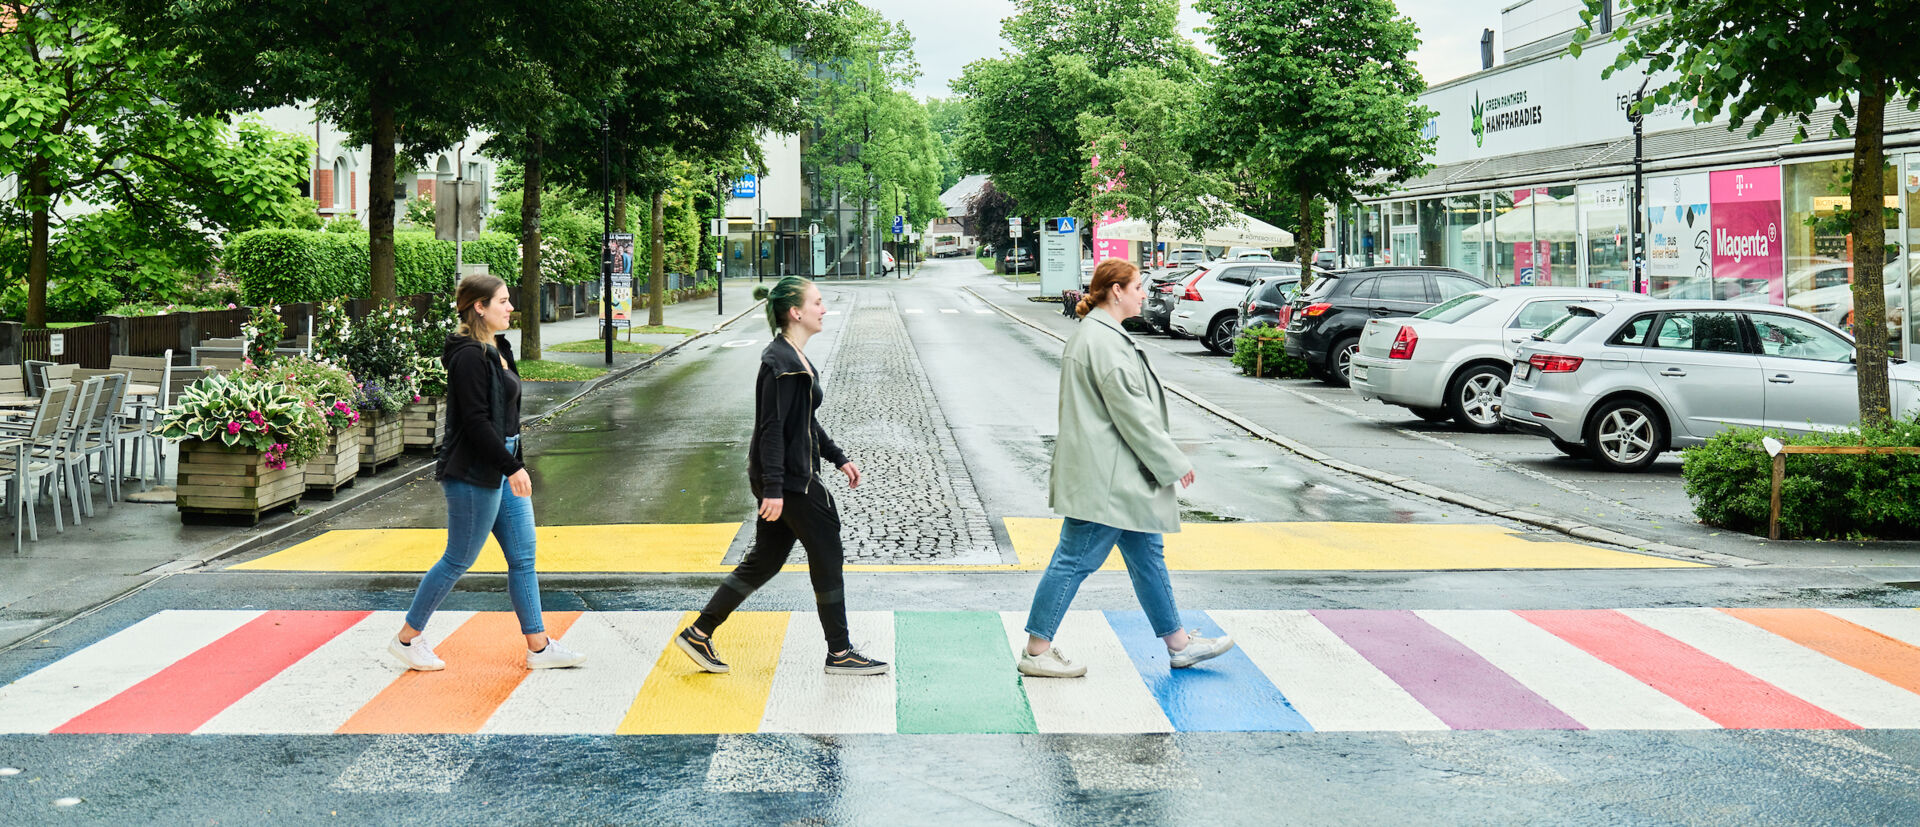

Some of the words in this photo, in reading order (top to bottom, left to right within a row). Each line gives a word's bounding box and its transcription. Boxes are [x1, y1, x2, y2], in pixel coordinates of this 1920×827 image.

[1485, 99, 1501, 111] GREEN
[1501, 90, 1528, 106] PANTHER'S
[1485, 104, 1542, 133] HANFPARADIES
[894, 216, 900, 225] P
[1716, 228, 1769, 263] Magenta
